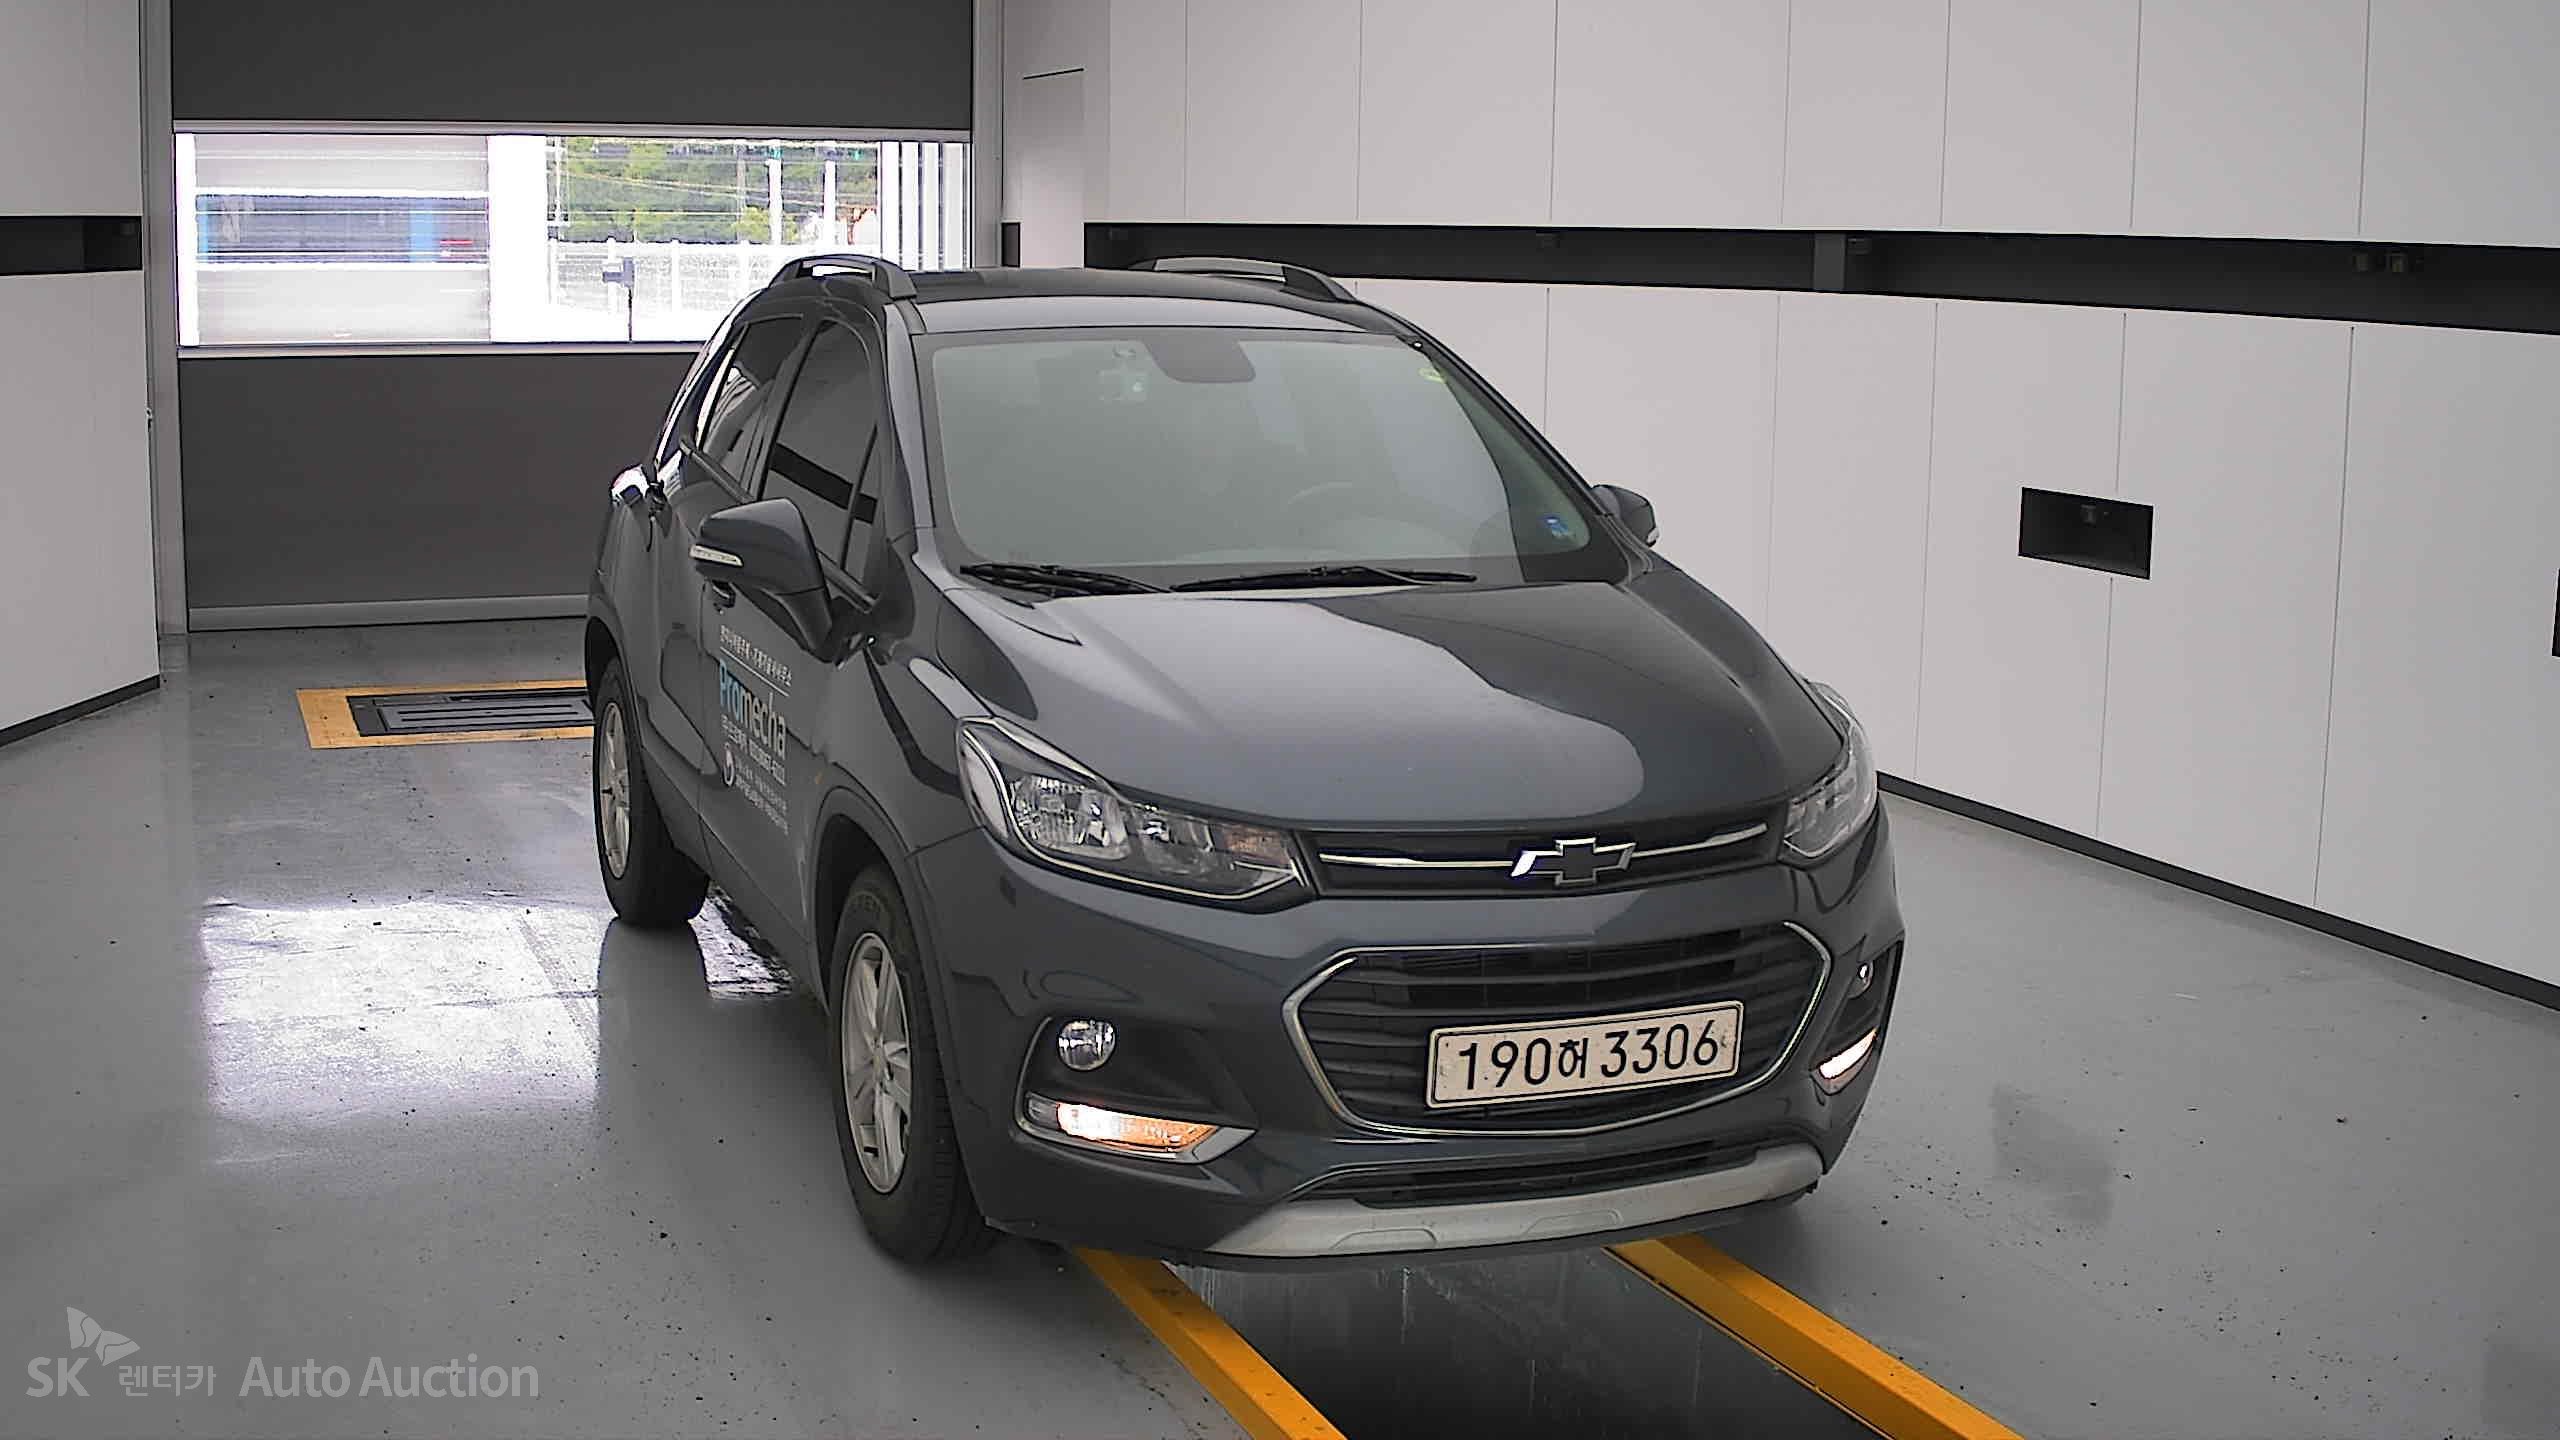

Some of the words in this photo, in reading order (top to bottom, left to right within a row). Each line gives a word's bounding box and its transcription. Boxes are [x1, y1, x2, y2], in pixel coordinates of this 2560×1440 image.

[719, 658, 786, 761] Promecha
[1458, 1037, 1588, 1090] 190허
[1600, 1019, 1719, 1078] 3306
